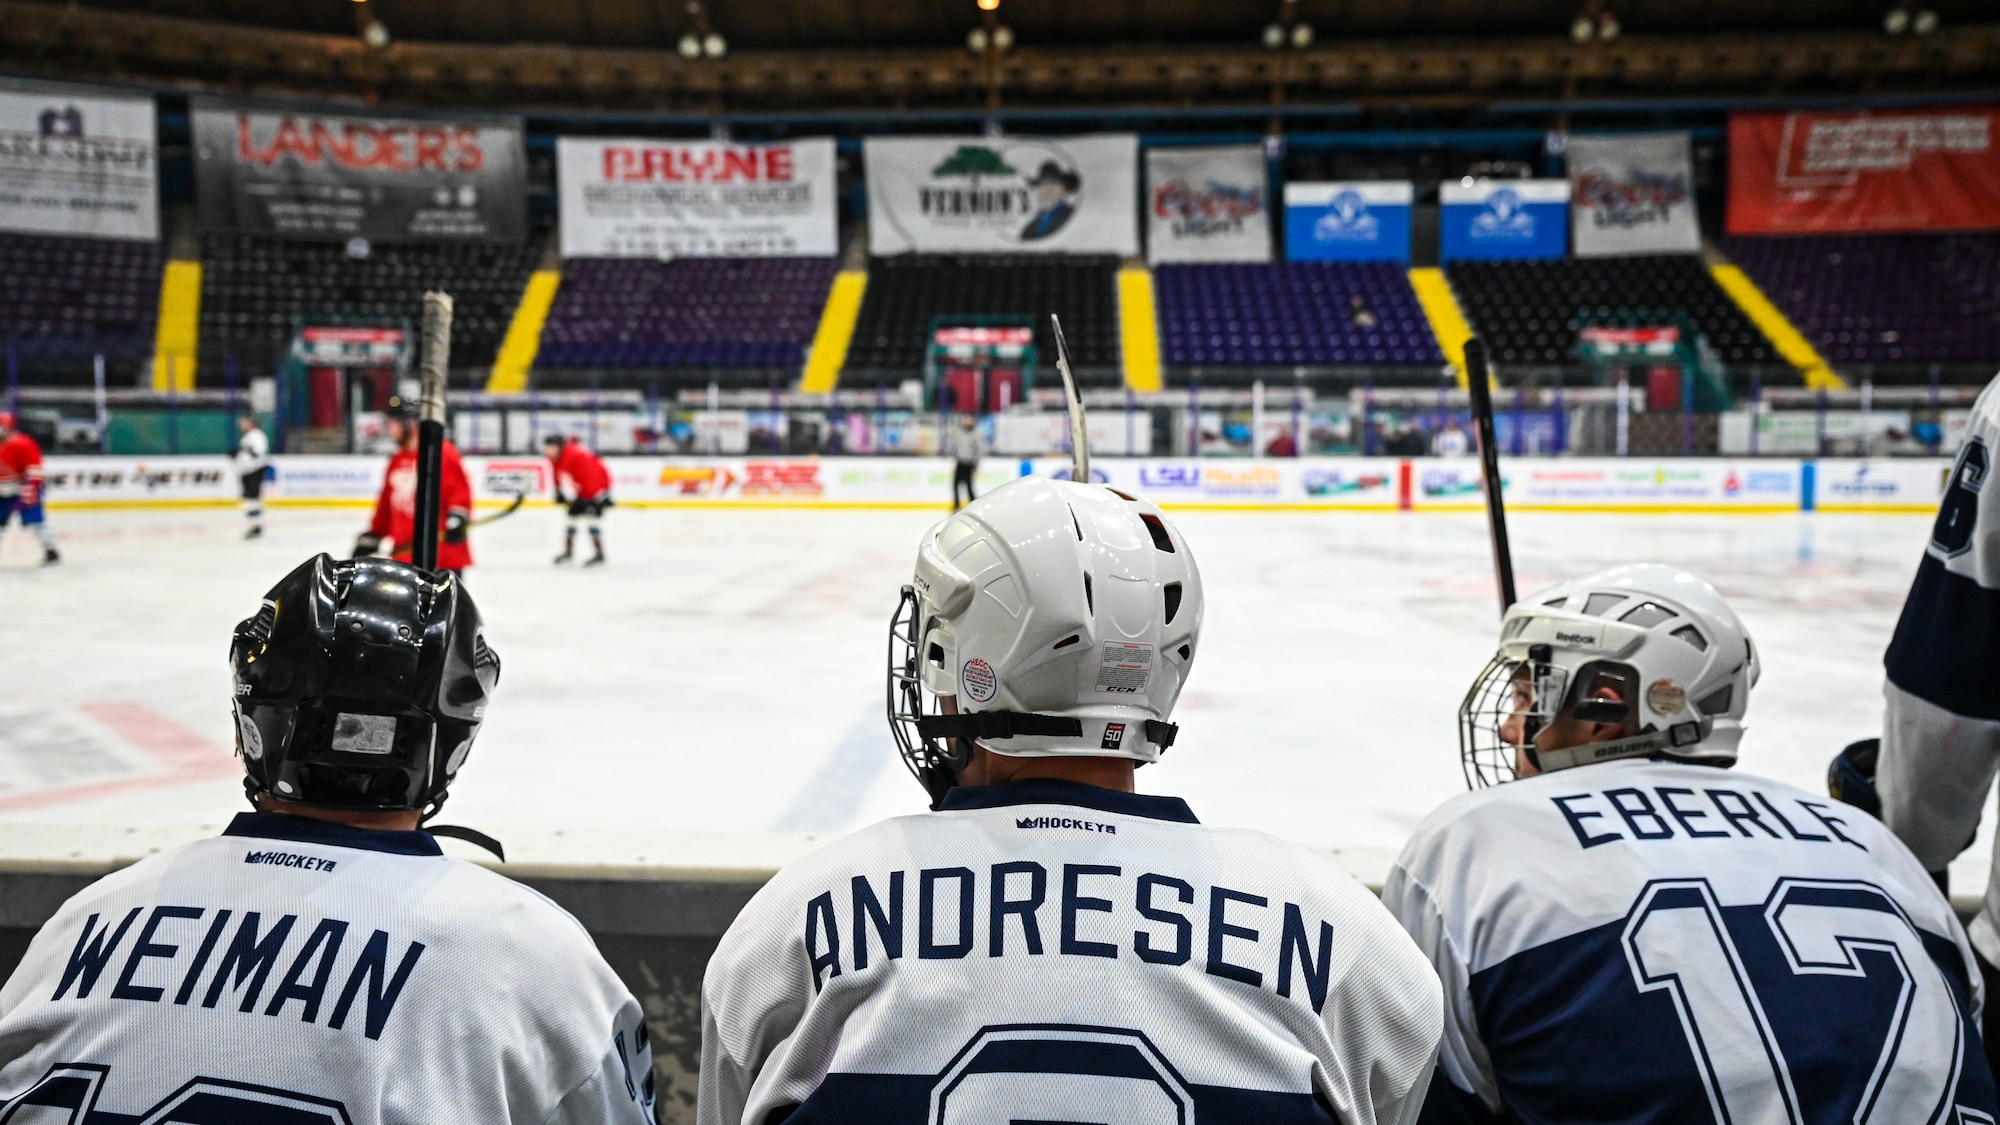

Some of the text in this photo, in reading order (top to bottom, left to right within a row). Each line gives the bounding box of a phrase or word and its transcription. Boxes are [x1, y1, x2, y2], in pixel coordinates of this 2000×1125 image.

[1139, 468, 1200, 487] LSU
[1555, 631, 1596, 645] Reebok
[1104, 730, 1122, 741] 50
[1594, 741, 1655, 758] BAUER
[1039, 817, 1105, 833] HOCKEY
[1551, 787, 1867, 851] EBERLE
[264, 851, 328, 871] HOCKEY
[805, 861, 1334, 1017] ANDRESEN
[51, 905, 426, 1042] WEIMAN
